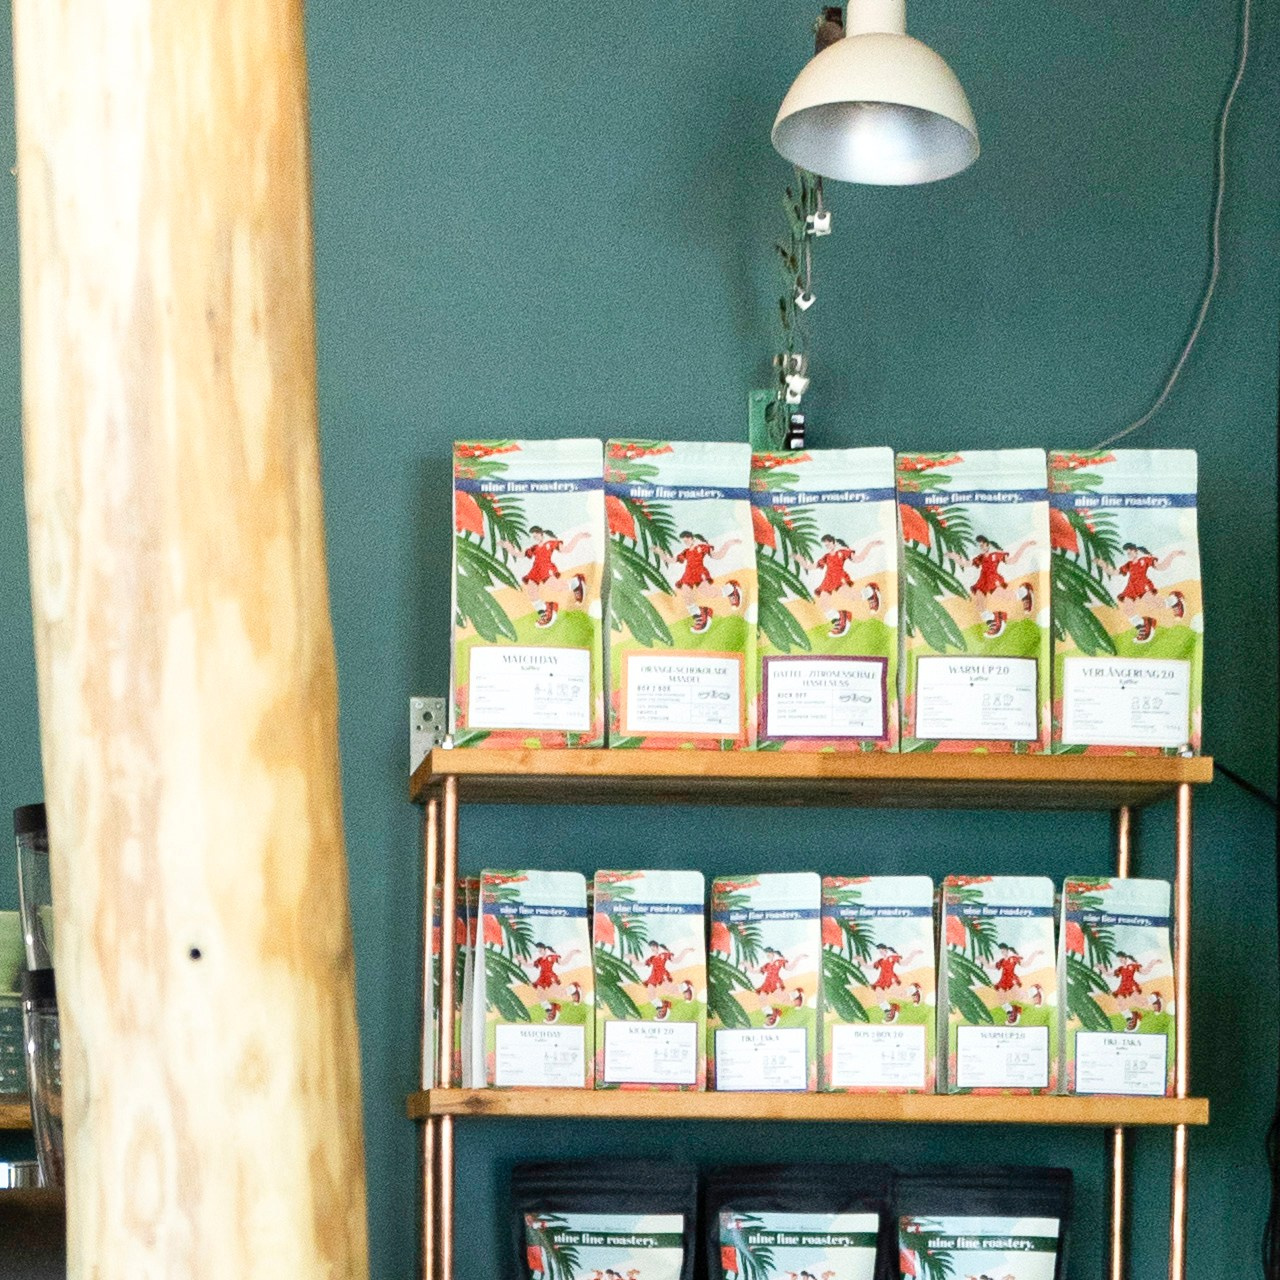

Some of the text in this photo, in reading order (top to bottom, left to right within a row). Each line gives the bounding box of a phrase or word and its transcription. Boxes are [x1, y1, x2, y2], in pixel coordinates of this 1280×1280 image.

[481, 482, 506, 492] nine
[507, 481, 528, 492] fine
[630, 487, 654, 498] nine
[655, 487, 677, 498] fine
[772, 493, 797, 505] nine
[798, 491, 819, 503] fine
[925, 494, 949, 505] nine
[951, 492, 972, 503] fine
[1075, 496, 1099, 507] nine
[1100, 496, 1122, 507] fine
[554, 1233, 658, 1248] nine fine roastery.
[748, 1233, 854, 1247] nine fine roastery.
[928, 1237, 1035, 1251] nine fine roastery.
